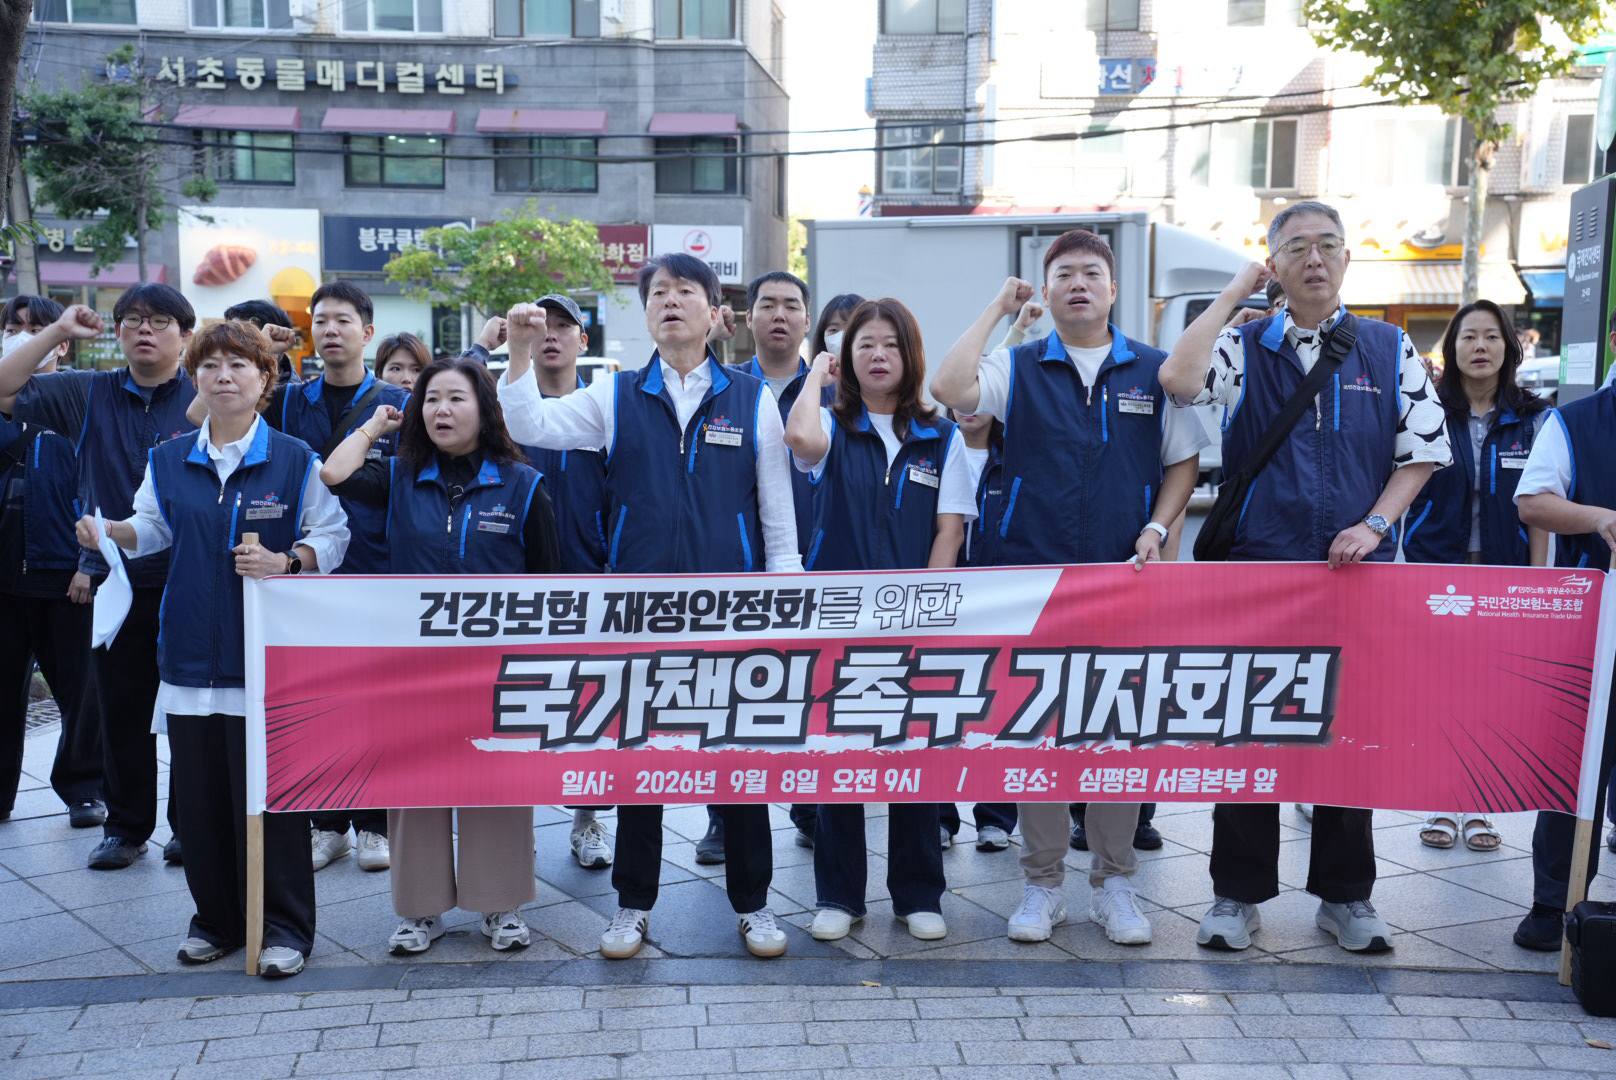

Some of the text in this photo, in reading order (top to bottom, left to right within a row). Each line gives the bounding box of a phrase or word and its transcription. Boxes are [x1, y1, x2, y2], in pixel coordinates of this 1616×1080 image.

[156, 55, 505, 95] 서초동물메디컬센터
[419, 583, 962, 637] 건강보험 재정안정화를 위한
[1477, 595, 1584, 611] 국민건강보험노동조합
[495, 647, 1340, 746] 국가책임 촉구 기자회견
[562, 770, 614, 796] 일시:
[635, 769, 716, 794] 2026년
[730, 768, 767, 794] 9월
[780, 768, 818, 794] 8일
[832, 768, 877, 794] 오전
[884, 768, 920, 794] 9시
[1003, 767, 1057, 793] 장소:
[1078, 767, 1148, 793] 심평원
[1154, 767, 1247, 793] 서울본부
[1253, 767, 1277, 793] 앞
